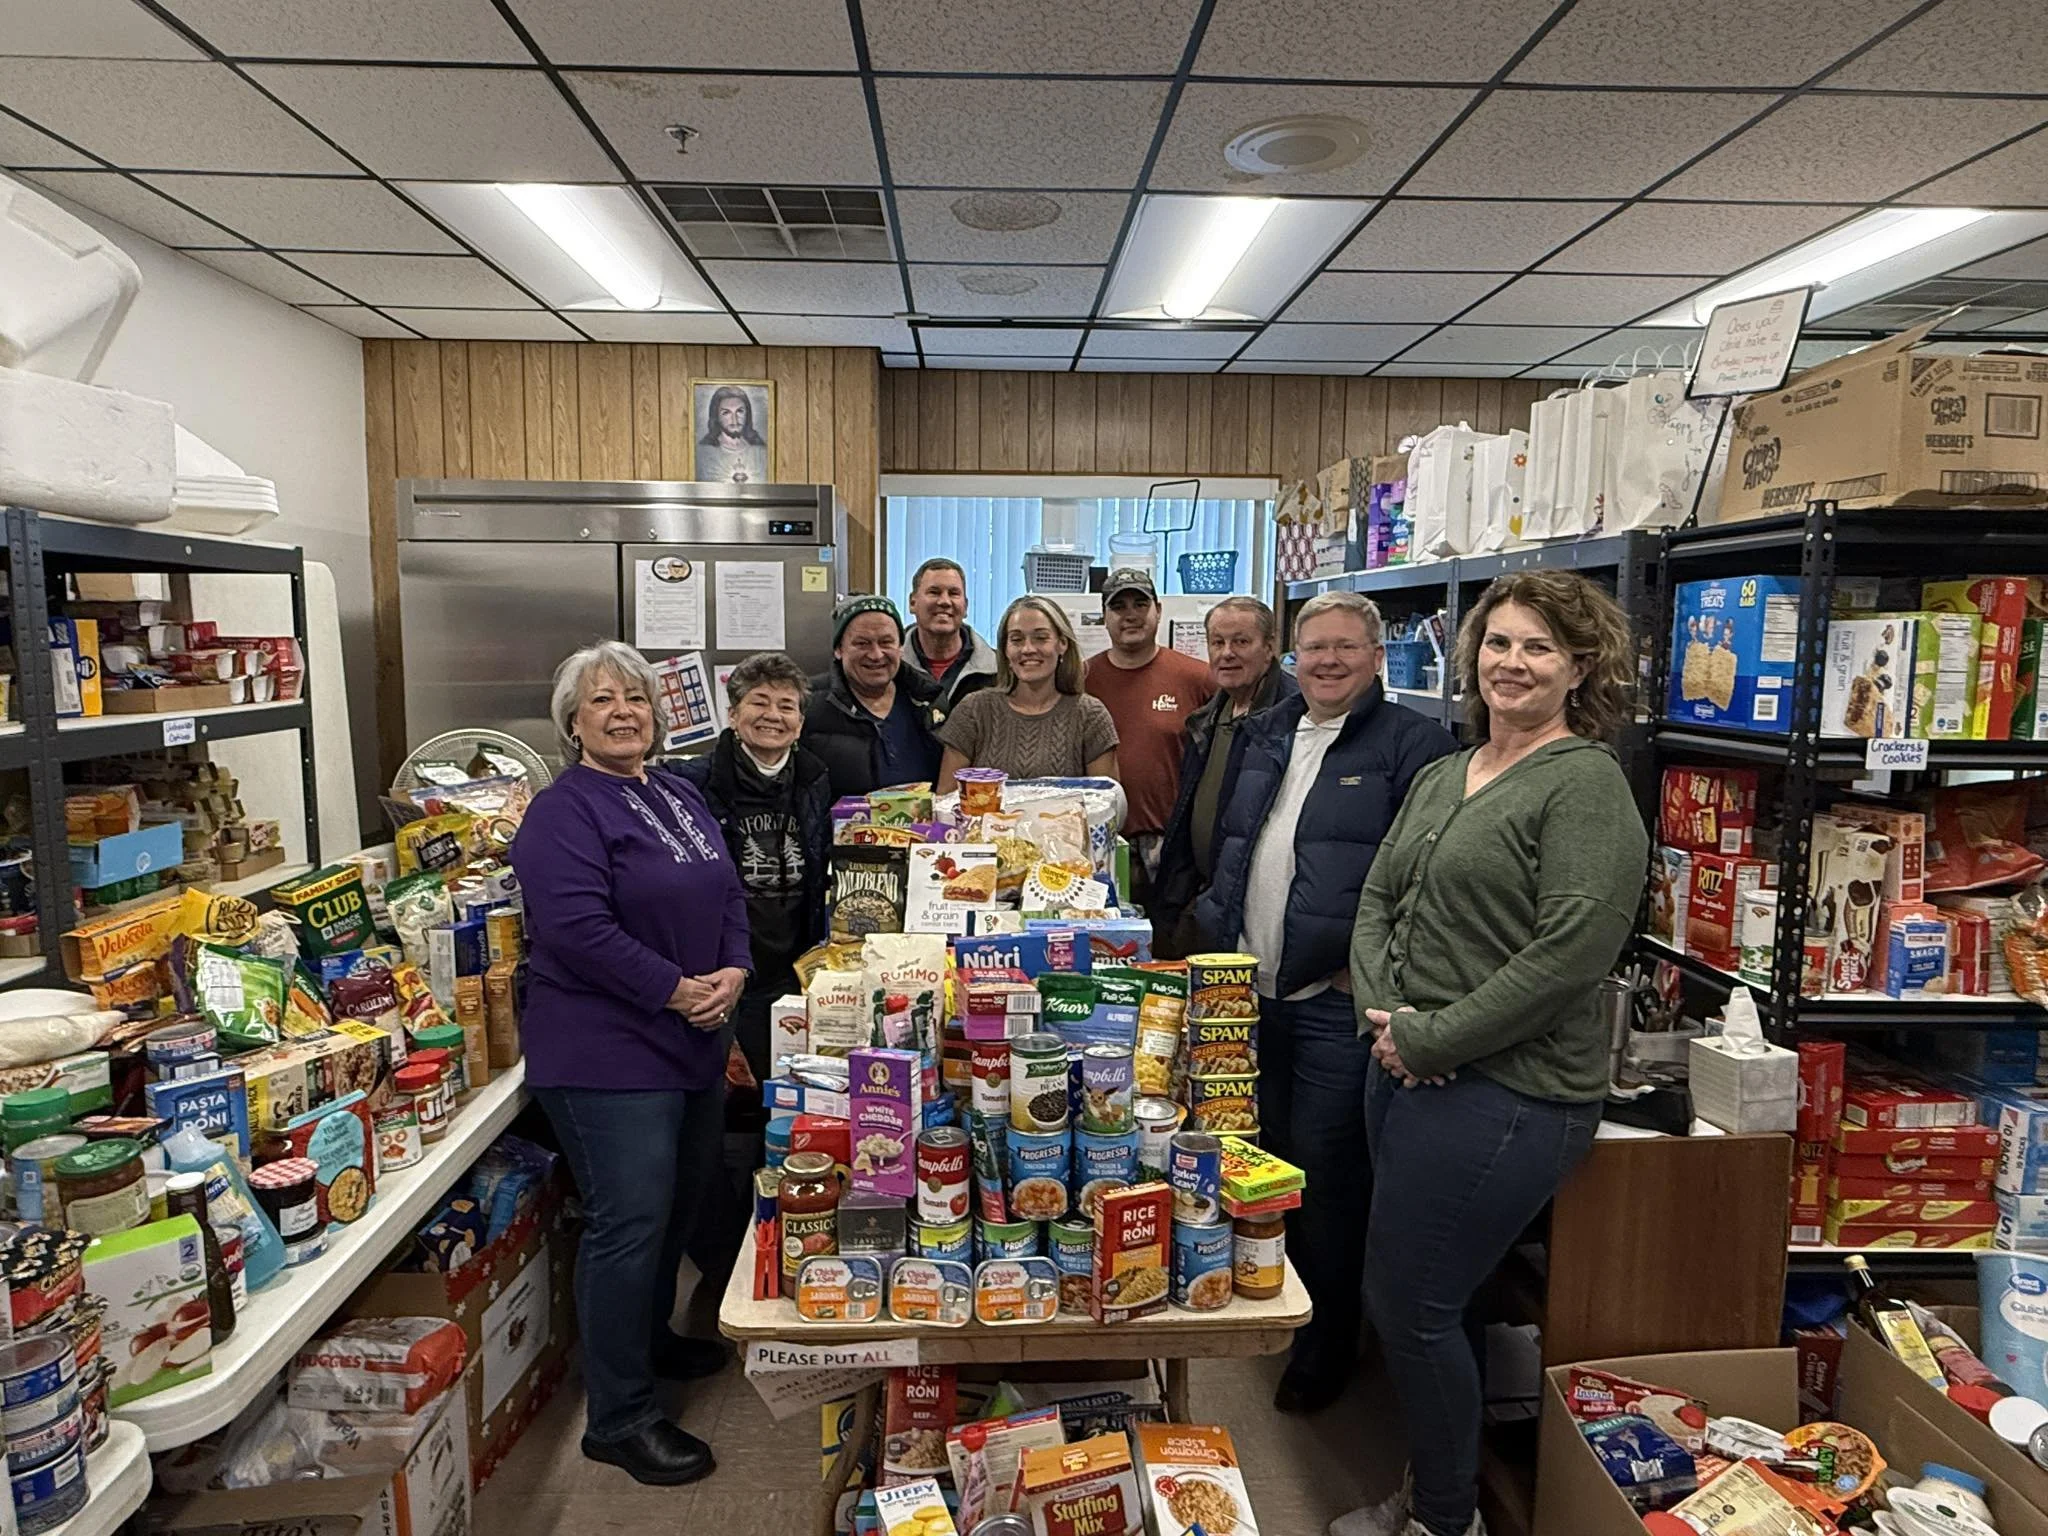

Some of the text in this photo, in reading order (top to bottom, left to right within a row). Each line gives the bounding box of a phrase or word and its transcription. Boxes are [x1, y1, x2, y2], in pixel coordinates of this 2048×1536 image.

[1910, 374, 1932, 397] FAMILY
[1926, 434, 1974, 448] HERSHEY'S
[1762, 482, 1815, 509] HERSHEY'S
[1742, 580, 1756, 596] 60
[1702, 598, 1724, 608] TREATS
[1844, 656, 1850, 664] &
[1838, 666, 1848, 692] grain
[1872, 740, 1915, 752] Crackers
[296, 870, 358, 900] FAMILY SIZE
[835, 870, 898, 902] WILD BLEND
[1698, 866, 1724, 893] RITZ
[308, 890, 362, 928] CLUB
[928, 902, 948, 911] fruit
[334, 912, 360, 926] SNACK
[921, 912, 959, 922] & grain
[100, 923, 154, 960] Velveeta
[963, 946, 1021, 968] Nutri
[1910, 948, 1940, 959] SNACK
[880, 968, 938, 983] RUMMO
[1202, 970, 1252, 984] SPAM
[1837, 952, 1850, 990] Snack
[295, 974, 318, 1001] Knorr
[346, 993, 396, 1016] CAROLINA
[818, 994, 857, 1006] RUMM
[1045, 997, 1092, 1015] Knorr
[1200, 1026, 1249, 1041] SPAM
[860, 1083, 900, 1098] Annie's
[1040, 1081, 1065, 1091] BEANS
[1204, 1082, 1253, 1096] SPAM
[178, 1094, 227, 1115] PASTA
[981, 1093, 1006, 1102] Tomato
[866, 1105, 895, 1116] WHITE
[182, 1112, 228, 1131] RONI
[859, 1114, 903, 1126] CHEDDAR
[1020, 1144, 1062, 1160] PROGRESSO
[1088, 1146, 1128, 1160] PROGRESSO
[2000, 1124, 2014, 1176] 10 PACKS
[1172, 1164, 1200, 1182] Turkey
[1172, 1177, 1198, 1192] Gravy
[922, 1197, 948, 1208] Tomato
[1123, 1205, 1156, 1222] RICE
[786, 1218, 836, 1233] CLASSICO
[1122, 1225, 1156, 1242] RONI
[183, 1244, 194, 1258] 2
[814, 1268, 844, 1277] Chicken
[907, 1271, 936, 1280] Chicken
[992, 1271, 1020, 1280] Chicken
[295, 1354, 362, 1369] HUGGIES
[758, 1348, 892, 1366] PLEASE PUT ALL
[907, 1366, 940, 1378] RICE
[906, 1386, 940, 1398] RONI
[1574, 1386, 1614, 1401] Instant
[913, 1412, 931, 1420] BEEF
[1160, 1445, 1219, 1463] Cinnamon
[880, 1484, 936, 1504] JIFFY
[1053, 1494, 1118, 1522] Stuffing
[1074, 1516, 1106, 1536] Mix
